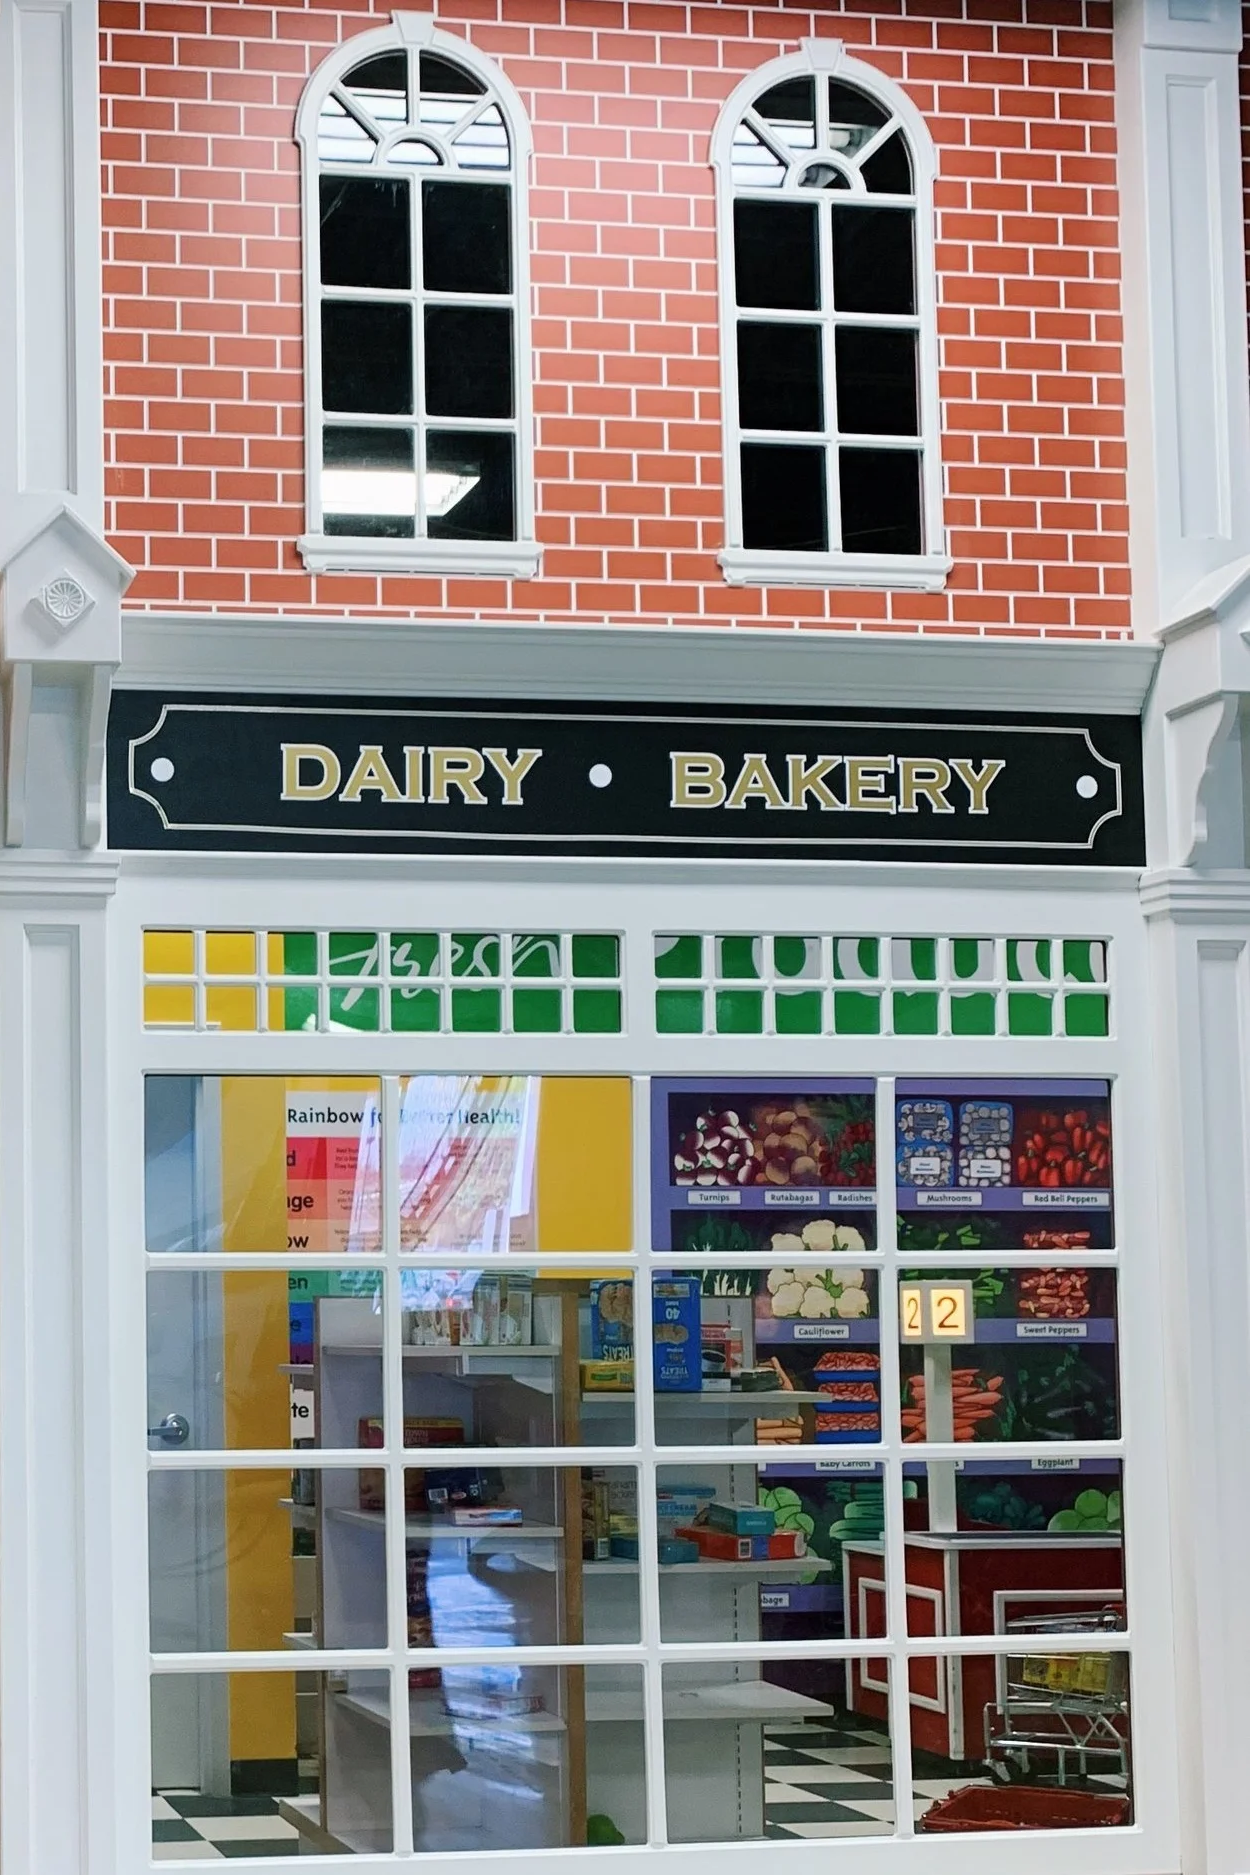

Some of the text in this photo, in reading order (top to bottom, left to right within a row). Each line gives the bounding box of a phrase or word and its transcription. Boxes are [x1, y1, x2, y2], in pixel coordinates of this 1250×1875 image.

[280, 742, 1007, 816] DAIRY BAKERY
[288, 1106, 364, 1124] Rainbow
[699, 1191, 730, 1203] Turnips
[771, 1191, 814, 1204] Rutabagas
[837, 1192, 873, 1202] Radishes
[927, 1194, 973, 1203] Mushrooms
[1034, 1194, 1098, 1205] Red Bell Peppers
[665, 1307, 680, 1320] 40
[907, 1297, 919, 1329] 2
[936, 1296, 959, 1329] 2
[798, 1326, 845, 1338] Cauliflower
[1023, 1325, 1080, 1337] Sweet Peppers
[1038, 1458, 1073, 1467] Eggplant
